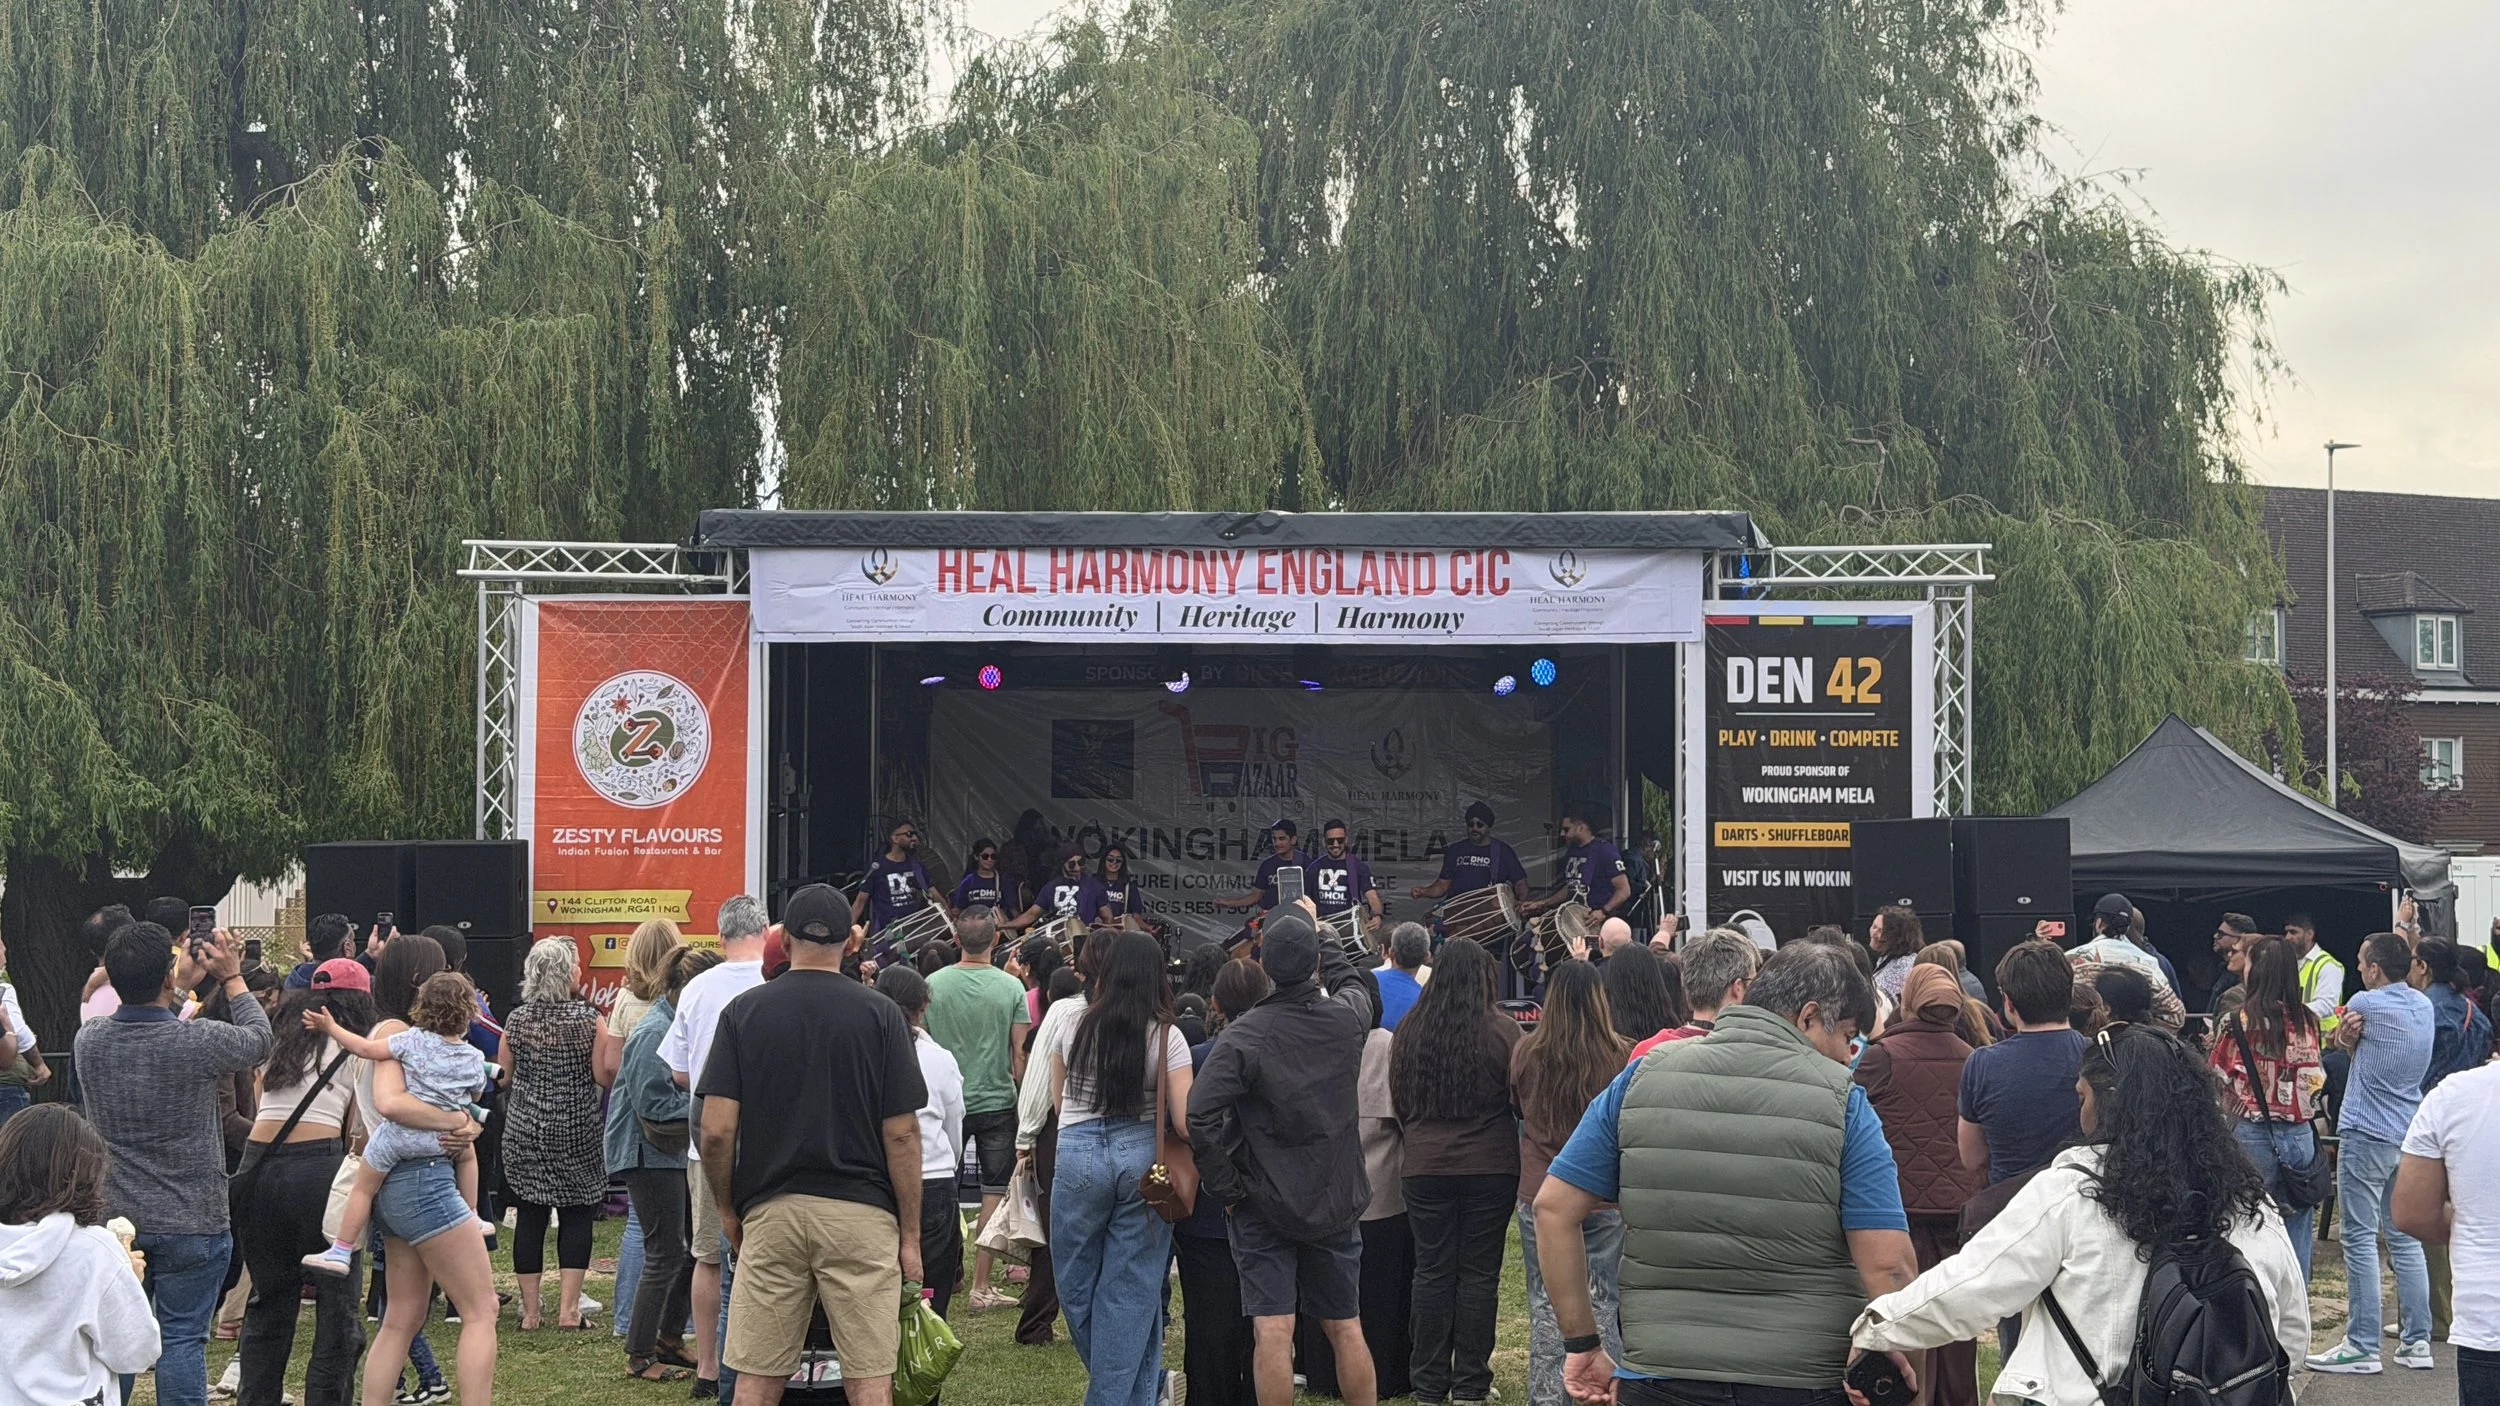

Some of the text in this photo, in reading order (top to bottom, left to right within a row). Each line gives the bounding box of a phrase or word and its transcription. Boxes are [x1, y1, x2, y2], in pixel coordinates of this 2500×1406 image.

[938, 548, 1511, 596] HEAL HARMONY ENGLAND CIC
[869, 593, 918, 602] HARMONY
[1530, 595, 1606, 604] HEAL HARMONY
[983, 602, 1465, 634] Community Heritage Harmony
[1200, 665, 1225, 680] BY
[1727, 656, 1882, 704] DEN 42
[1718, 729, 1899, 747] PLAY DRINK COMPETE
[1761, 766, 1850, 777] PROUD SPONSOR OF
[1381, 791, 1440, 801] HARMONY
[1742, 787, 1875, 804] WOKINGHAM MELA
[552, 828, 723, 844] ZESTY FLAVOURS
[1721, 829, 1850, 842] DARTS SHUFFLEBOAR
[558, 846, 722, 856] Indian Fusion Restaurant & Bar
[1471, 855, 1491, 865] DHO
[1182, 874, 1256, 889] COMMU
[1723, 870, 1852, 886] VISIT US IN WOKIN
[585, 897, 627, 906] CLIFTON
[630, 897, 657, 905] ROAD
[560, 906, 622, 914] WOKINGHAM
[691, 940, 721, 949] OURS
